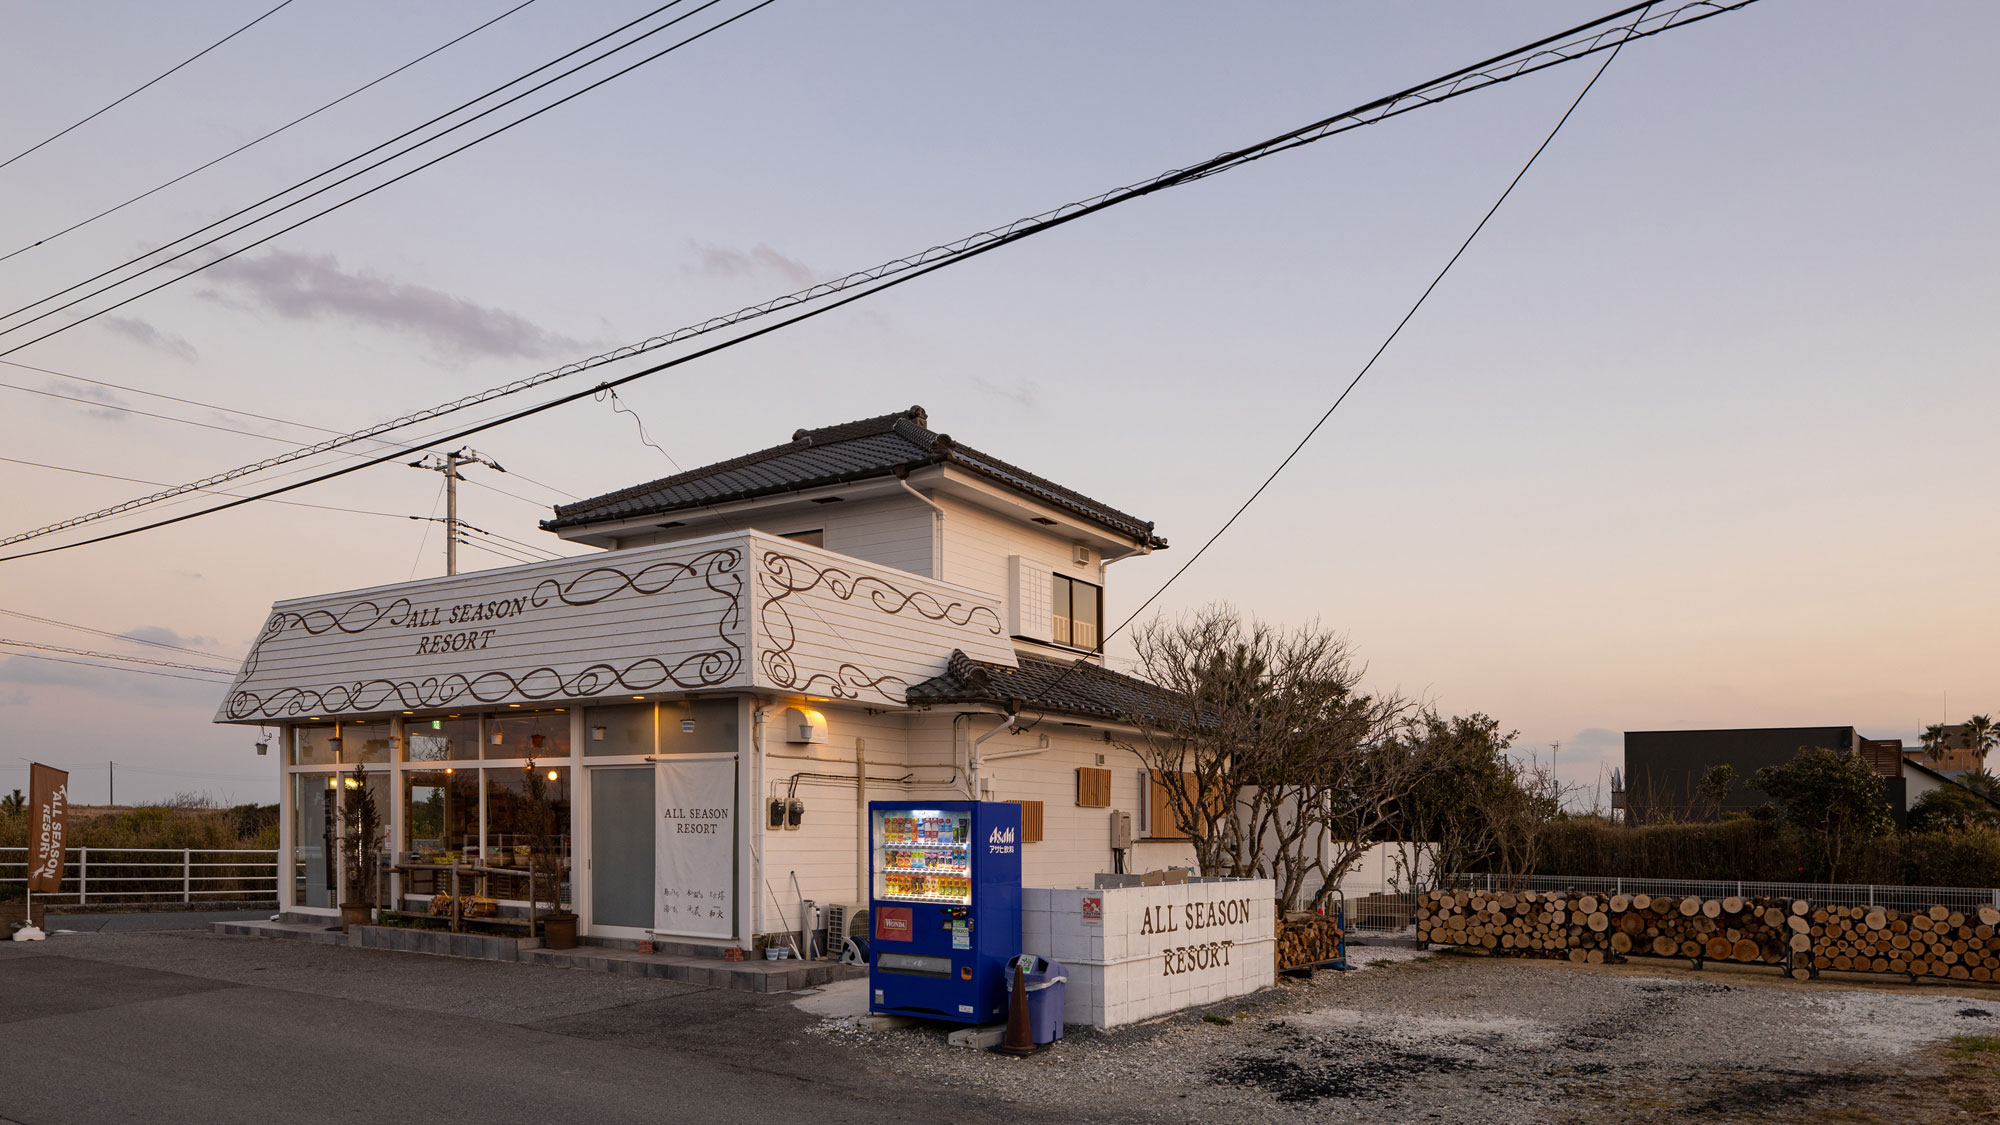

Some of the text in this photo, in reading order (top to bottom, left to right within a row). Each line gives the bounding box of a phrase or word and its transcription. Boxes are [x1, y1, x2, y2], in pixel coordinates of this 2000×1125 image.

[406, 596, 528, 629] ALL SEASON
[415, 629, 496, 655] RESORT
[664, 808, 728, 819] ALL SEASON
[39, 803, 51, 861] RESORT
[43, 790, 63, 879] ALL SEASON
[676, 823, 718, 834] RESORT
[989, 826, 1015, 844] Asahi
[885, 918, 906, 928] WONDA
[1140, 898, 1250, 936] ALL SEASON
[1162, 940, 1235, 977] RESORT
